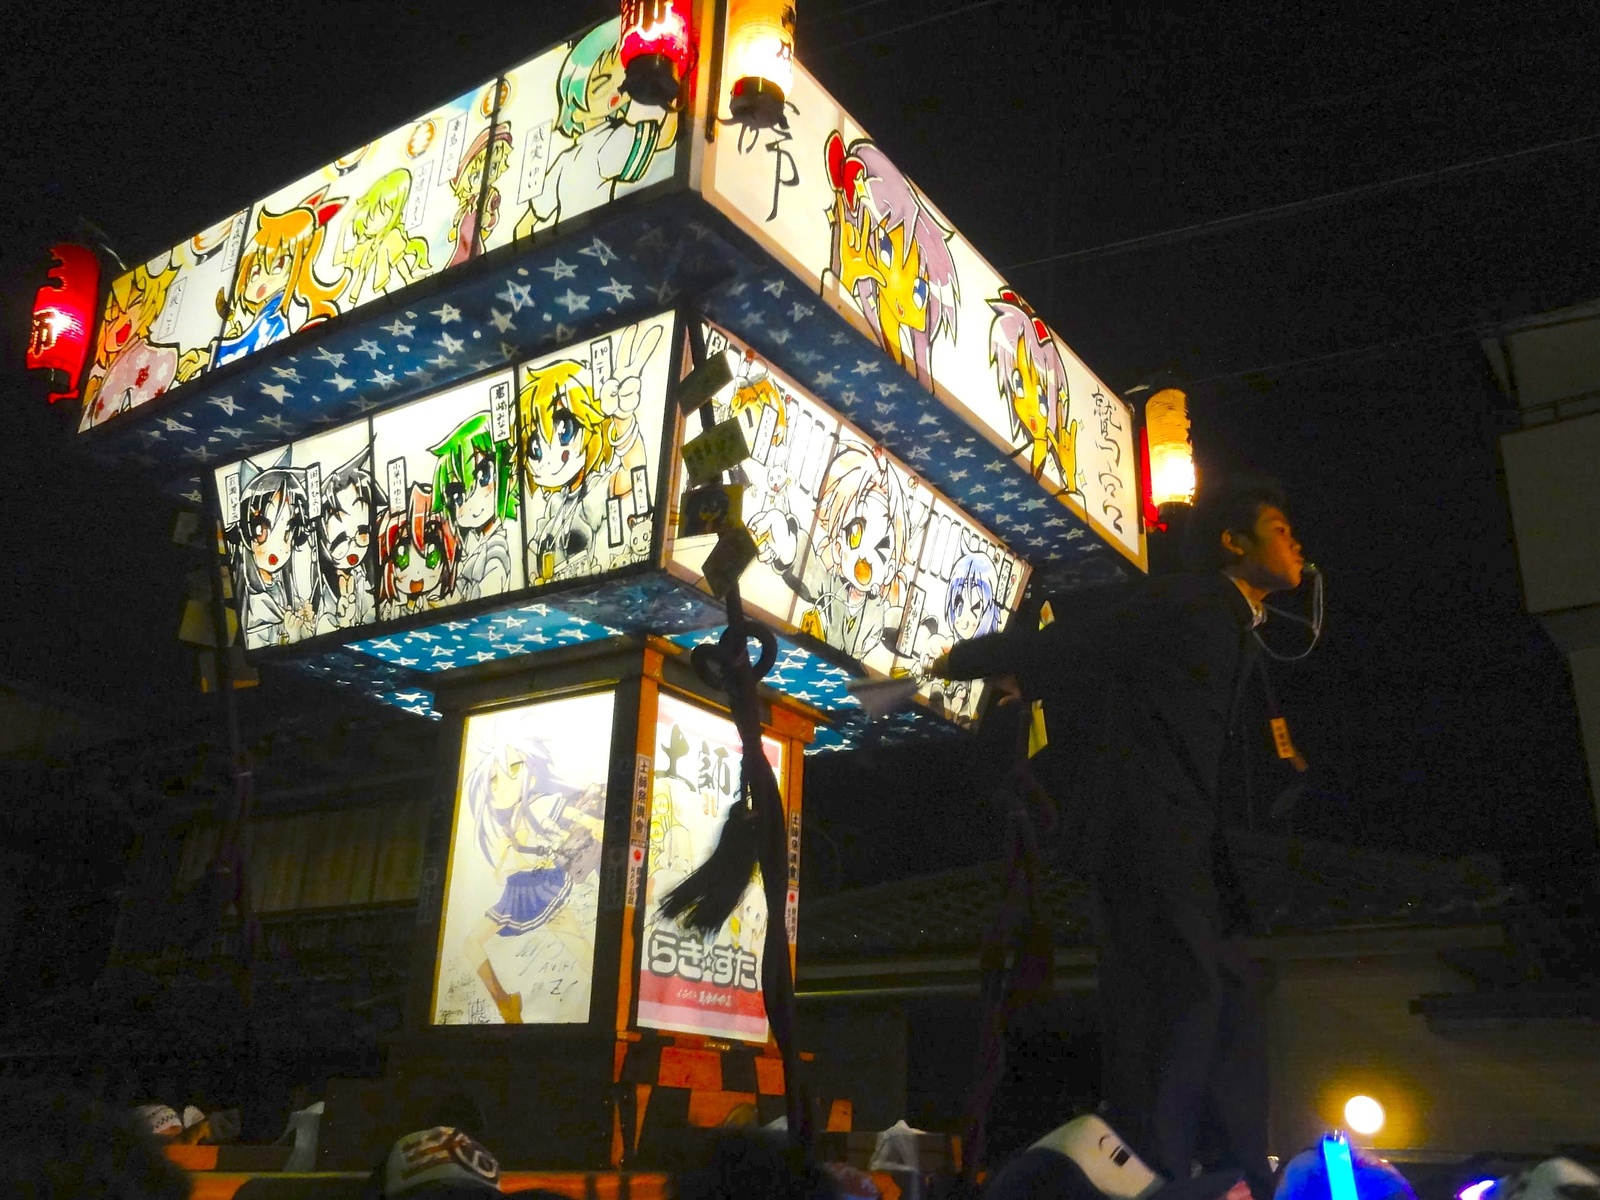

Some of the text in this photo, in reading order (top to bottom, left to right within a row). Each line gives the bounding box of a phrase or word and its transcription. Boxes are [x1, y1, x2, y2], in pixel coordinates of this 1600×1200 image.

[309, 469, 320, 514] 田村ひより
[648, 929, 758, 993] らき☆すた
